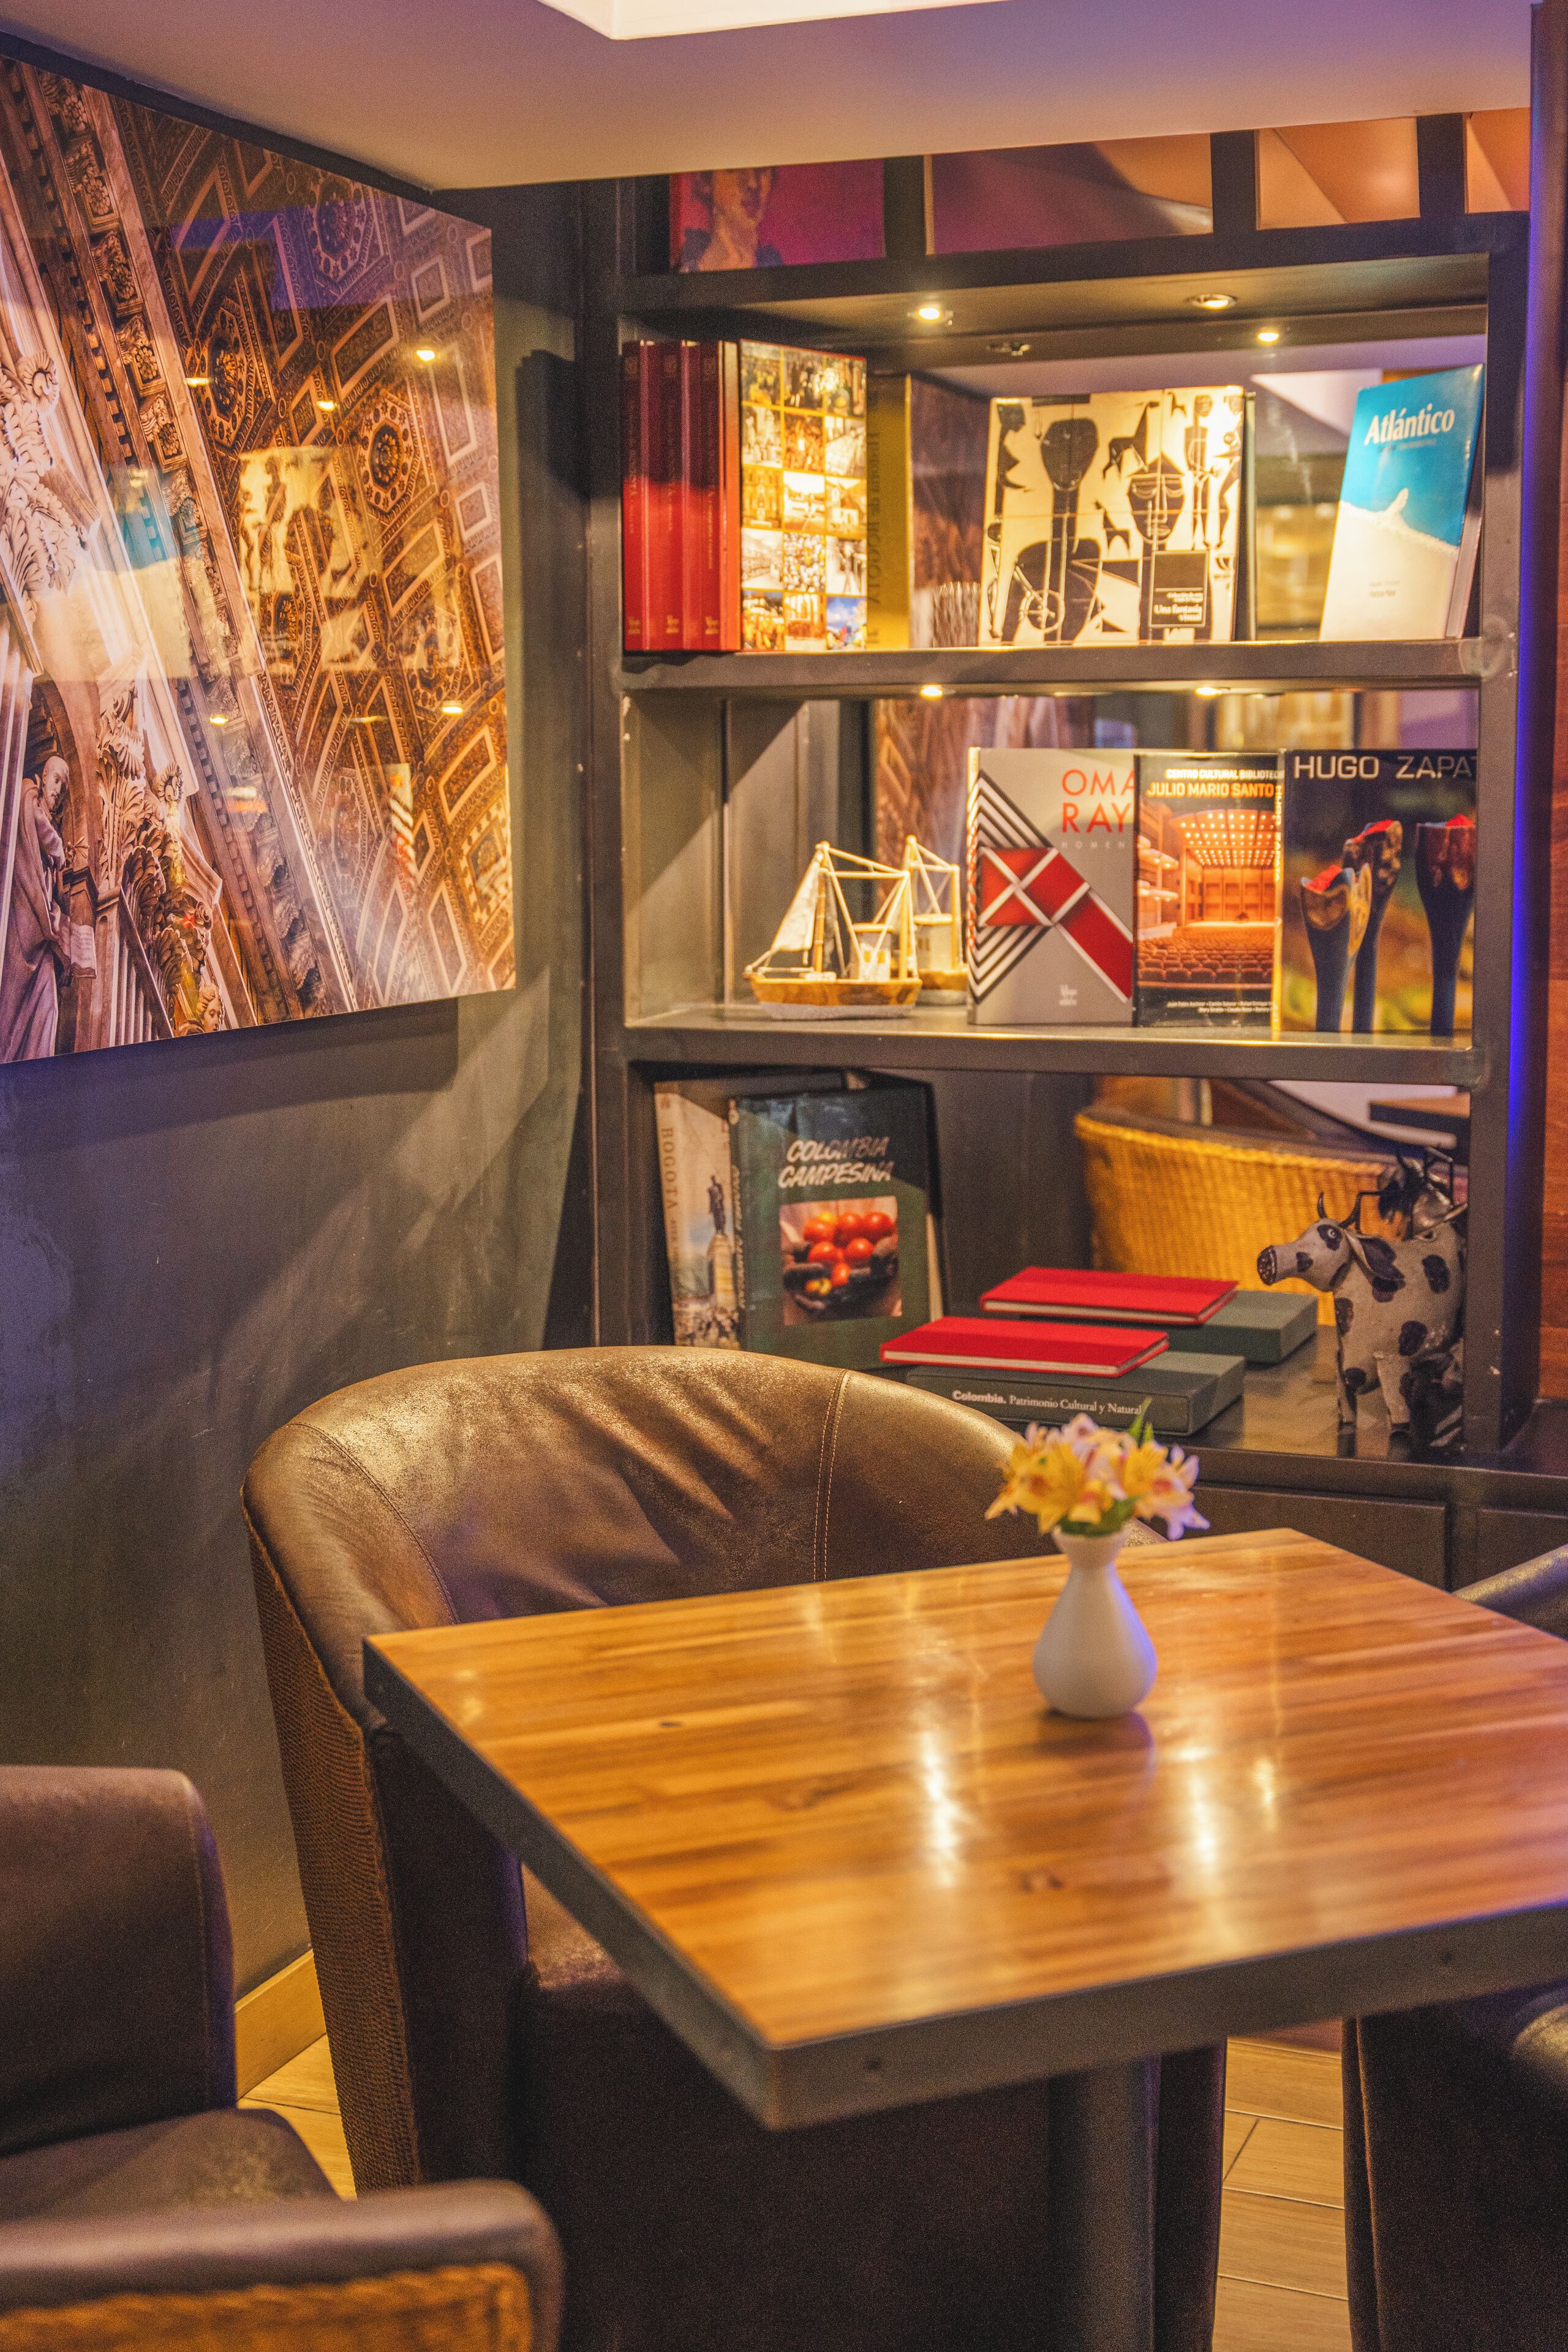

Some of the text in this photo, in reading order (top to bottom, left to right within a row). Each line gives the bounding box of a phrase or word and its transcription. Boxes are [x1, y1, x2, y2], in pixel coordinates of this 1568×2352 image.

[1363, 403, 1455, 447] Atlántico
[1165, 769, 1199, 780] CENTRO
[1199, 769, 1238, 780] CULTURAL
[1294, 755, 1380, 779] HUGO
[1061, 769, 1135, 796] OMA
[1146, 783, 1284, 797] JULIO MARIO SANTO
[1062, 802, 1132, 834] RAY
[786, 1136, 891, 1163] COLOMBIA
[778, 1161, 894, 1188] CAMPESINA
[952, 1390, 1142, 1415] Colombia. Patrimonio Cultural y Natural
